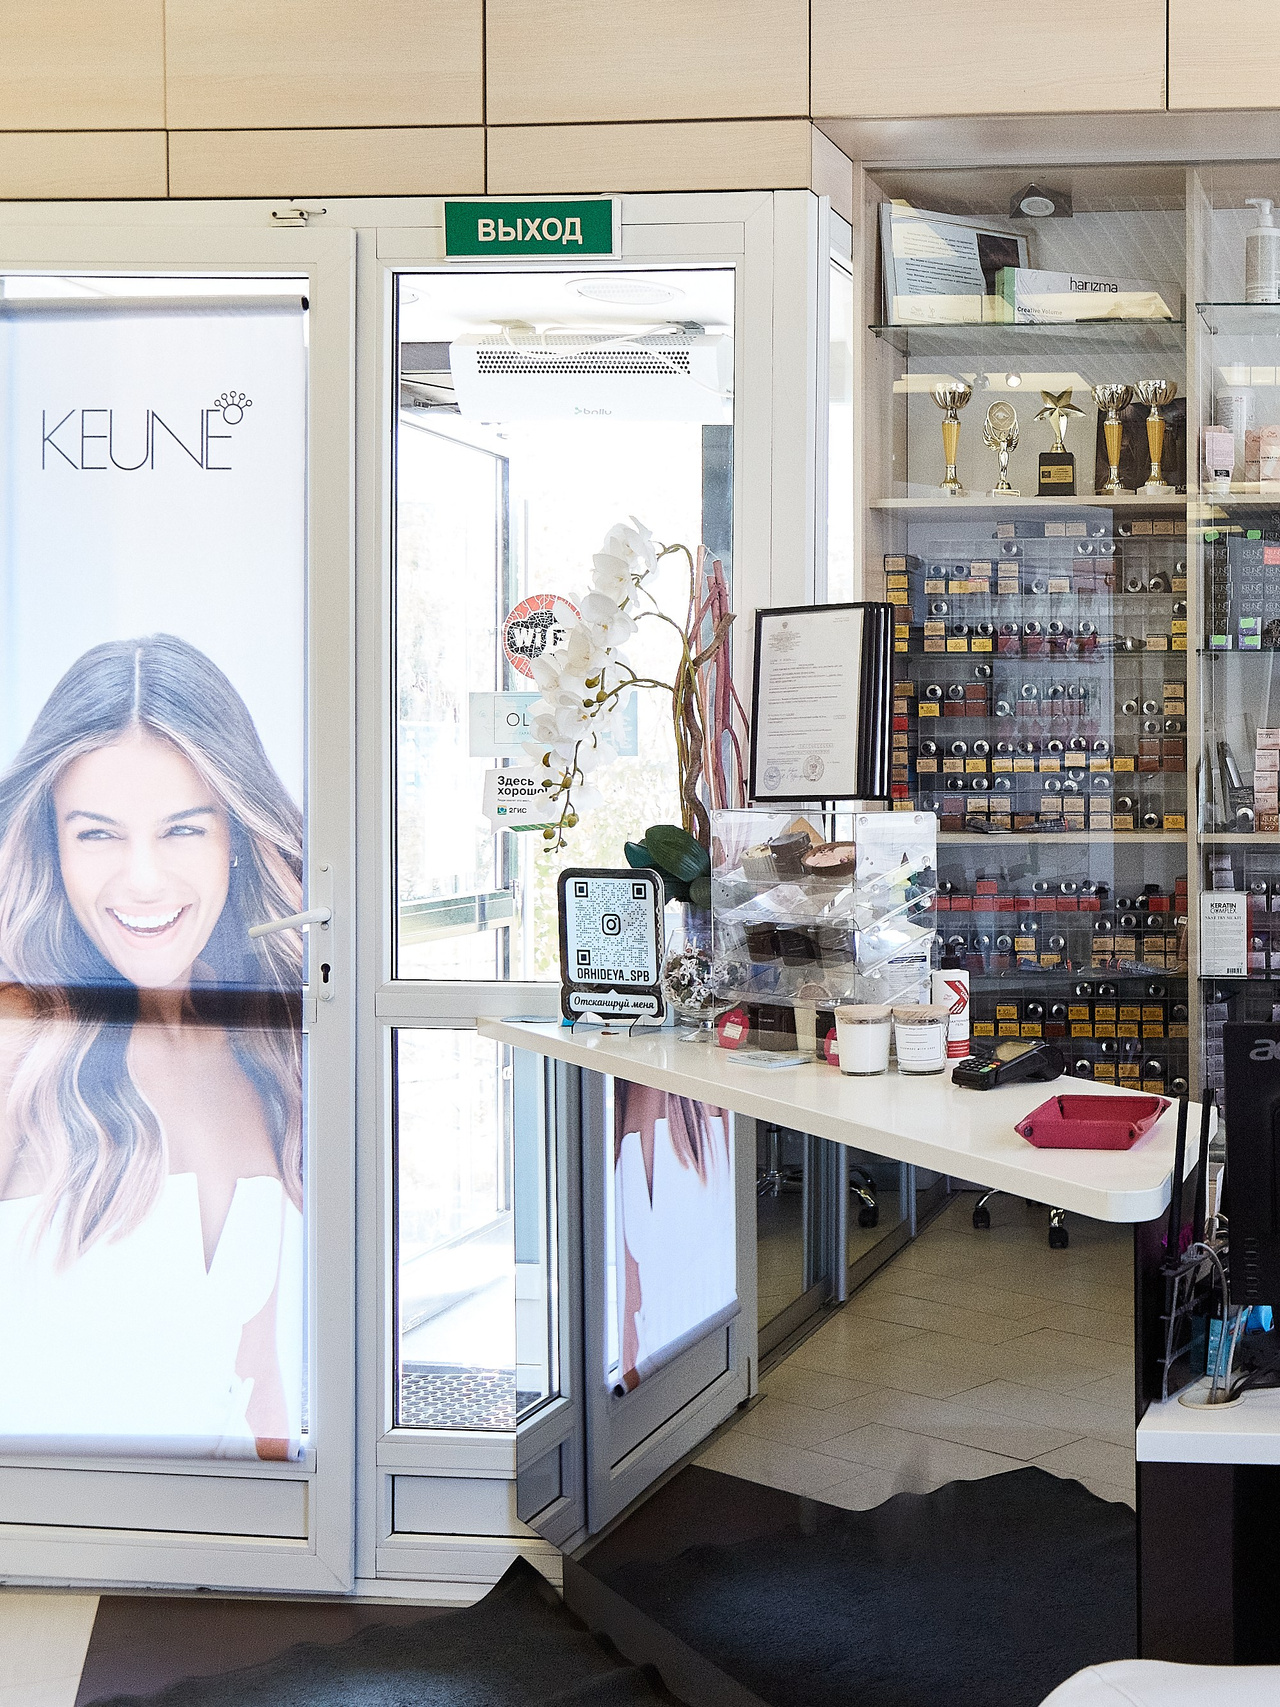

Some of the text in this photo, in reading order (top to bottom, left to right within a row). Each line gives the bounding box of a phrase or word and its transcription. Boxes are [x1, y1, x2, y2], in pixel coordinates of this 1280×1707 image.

[477, 217, 584, 245] ВЫХОД
[1069, 276, 1118, 293] harizma
[1017, 306, 1063, 316] Creative Volume
[42, 409, 232, 471] KEUNE
[497, 775, 535, 787] Здесь
[577, 967, 650, 982] ORHIDEYA_SPB
[574, 996, 655, 1011] Отсканируй меня
